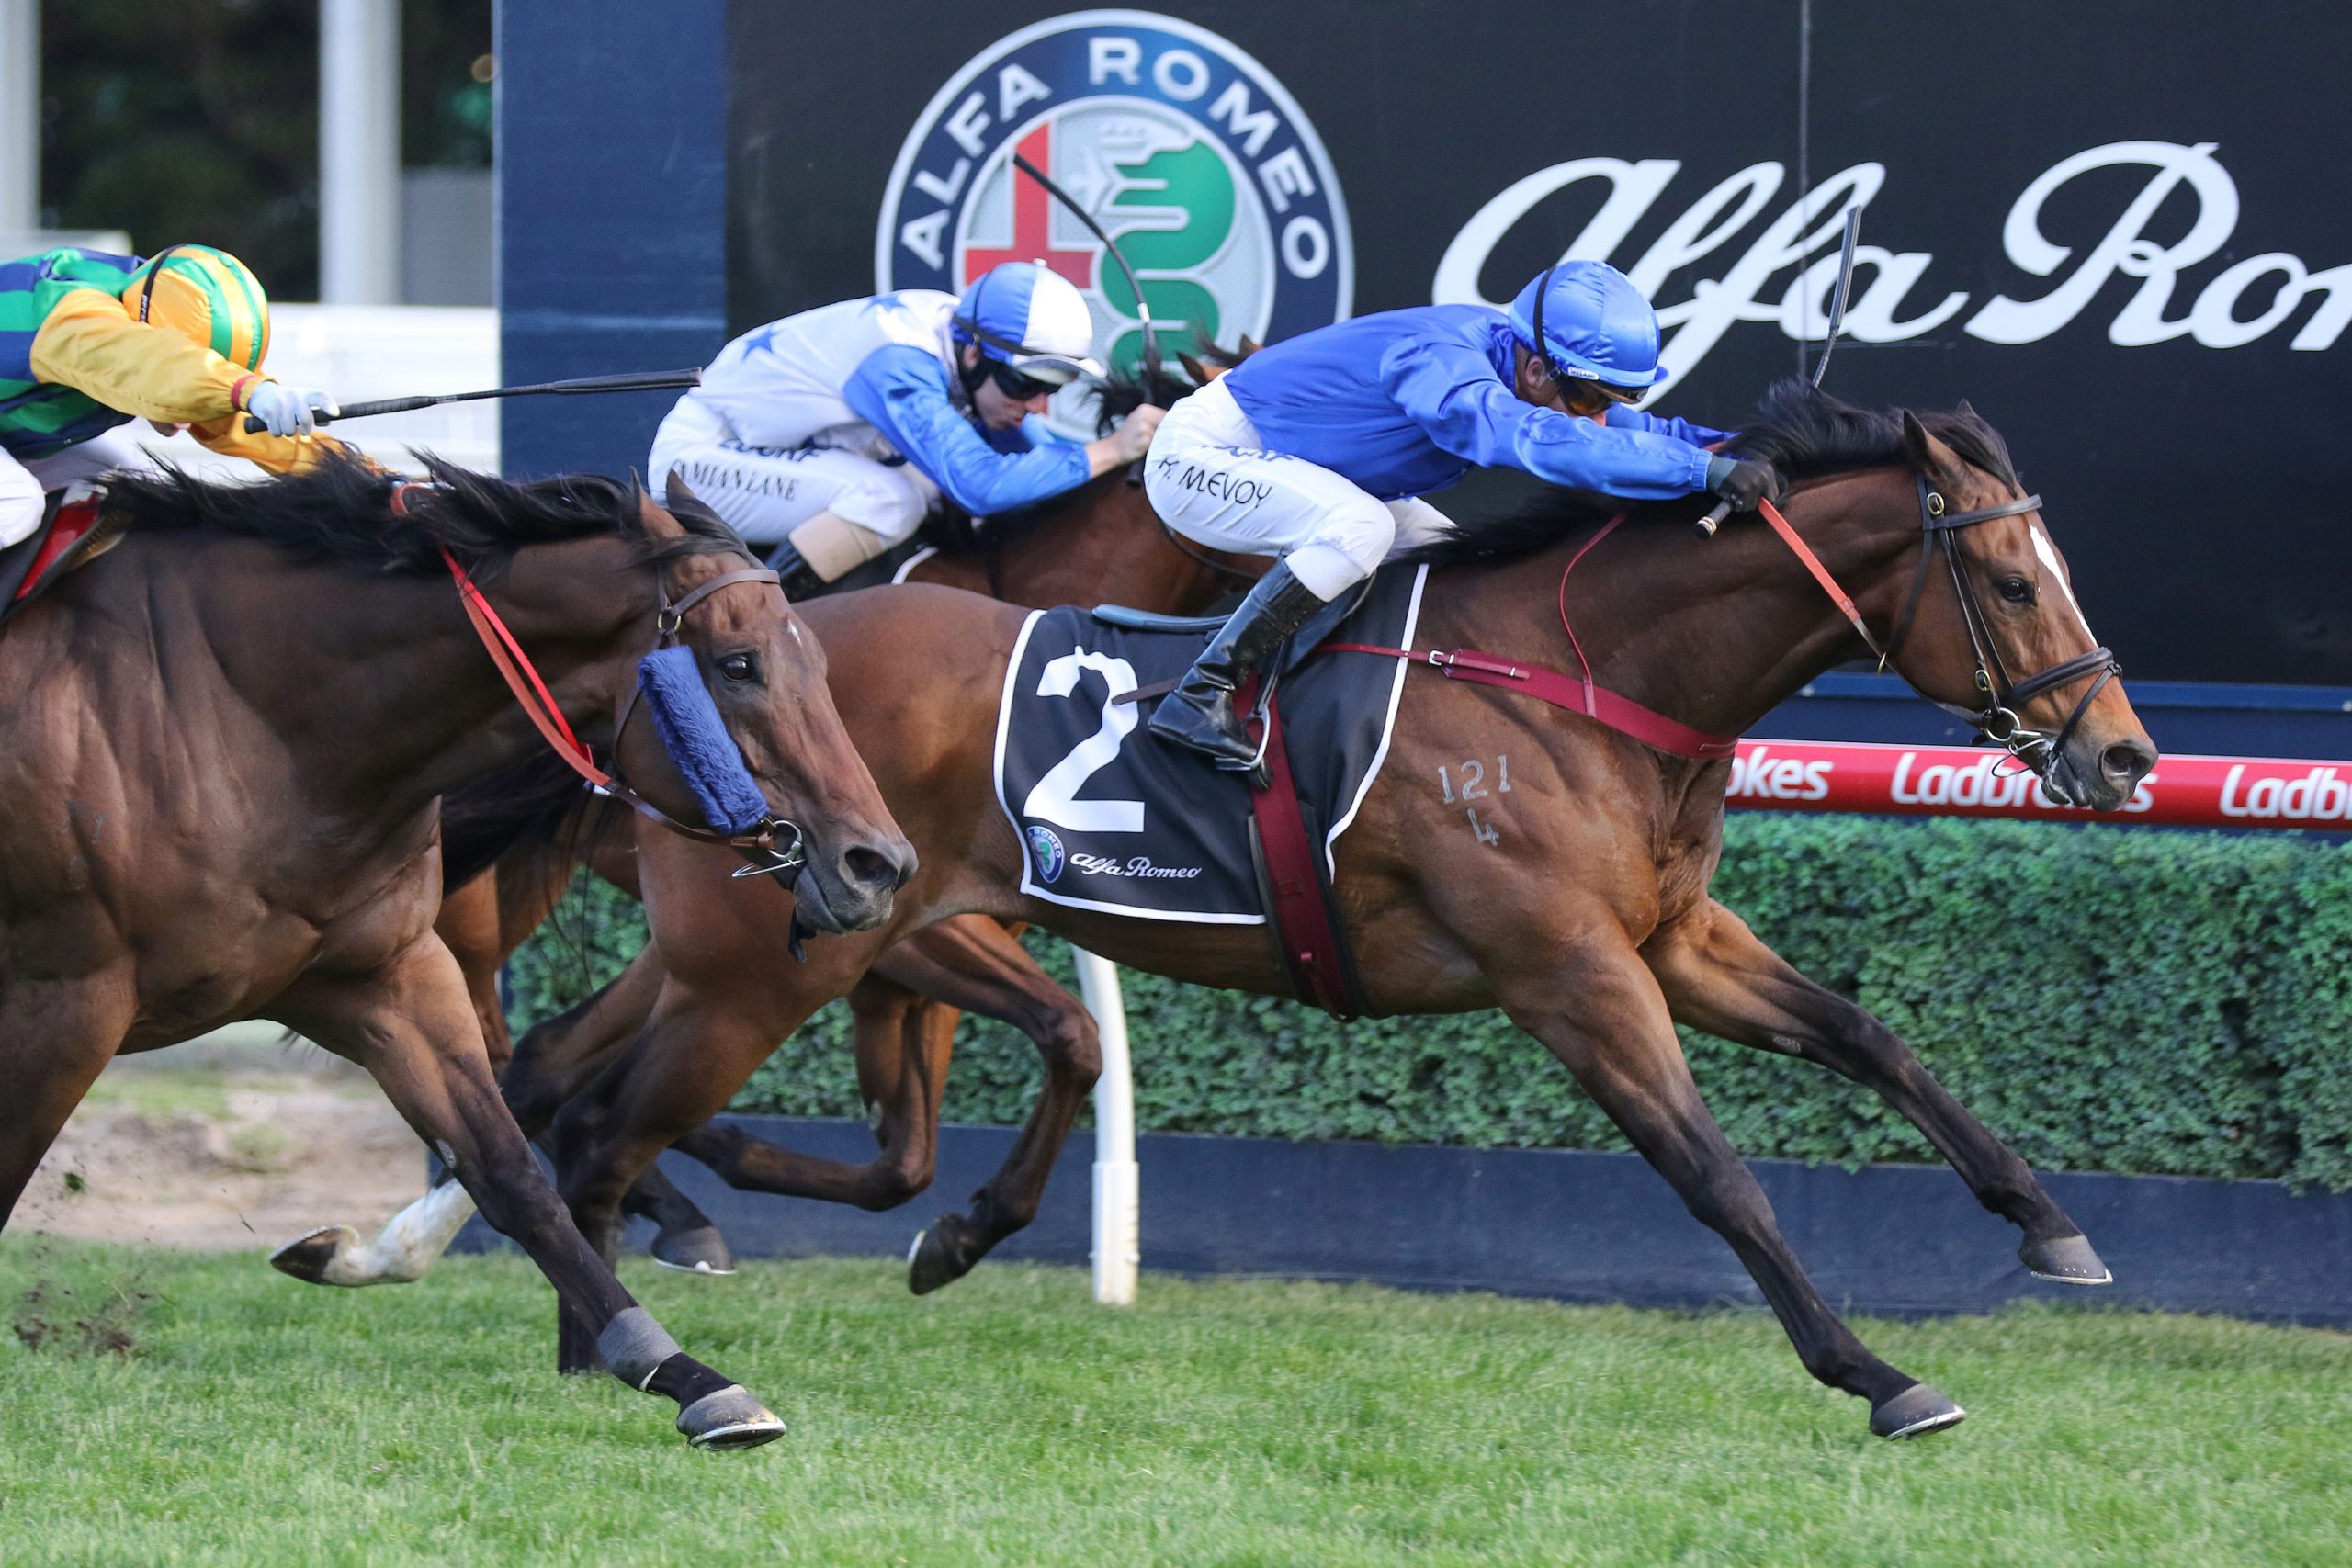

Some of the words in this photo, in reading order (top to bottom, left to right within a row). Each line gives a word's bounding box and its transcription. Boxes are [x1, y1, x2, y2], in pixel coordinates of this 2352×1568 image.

[901, 63, 1051, 271] ALFA
[1090, 37, 1329, 279] ROMEO
[1431, 156, 1970, 412] Alfa
[1023, 645, 1145, 832] 2
[1438, 754, 1511, 804] 121
[1890, 752, 2158, 814] Ladbrs
[2220, 763, 2352, 820] Ladb
[1070, 852, 1125, 875] Alfa
[1124, 856, 1203, 879] Romeo
